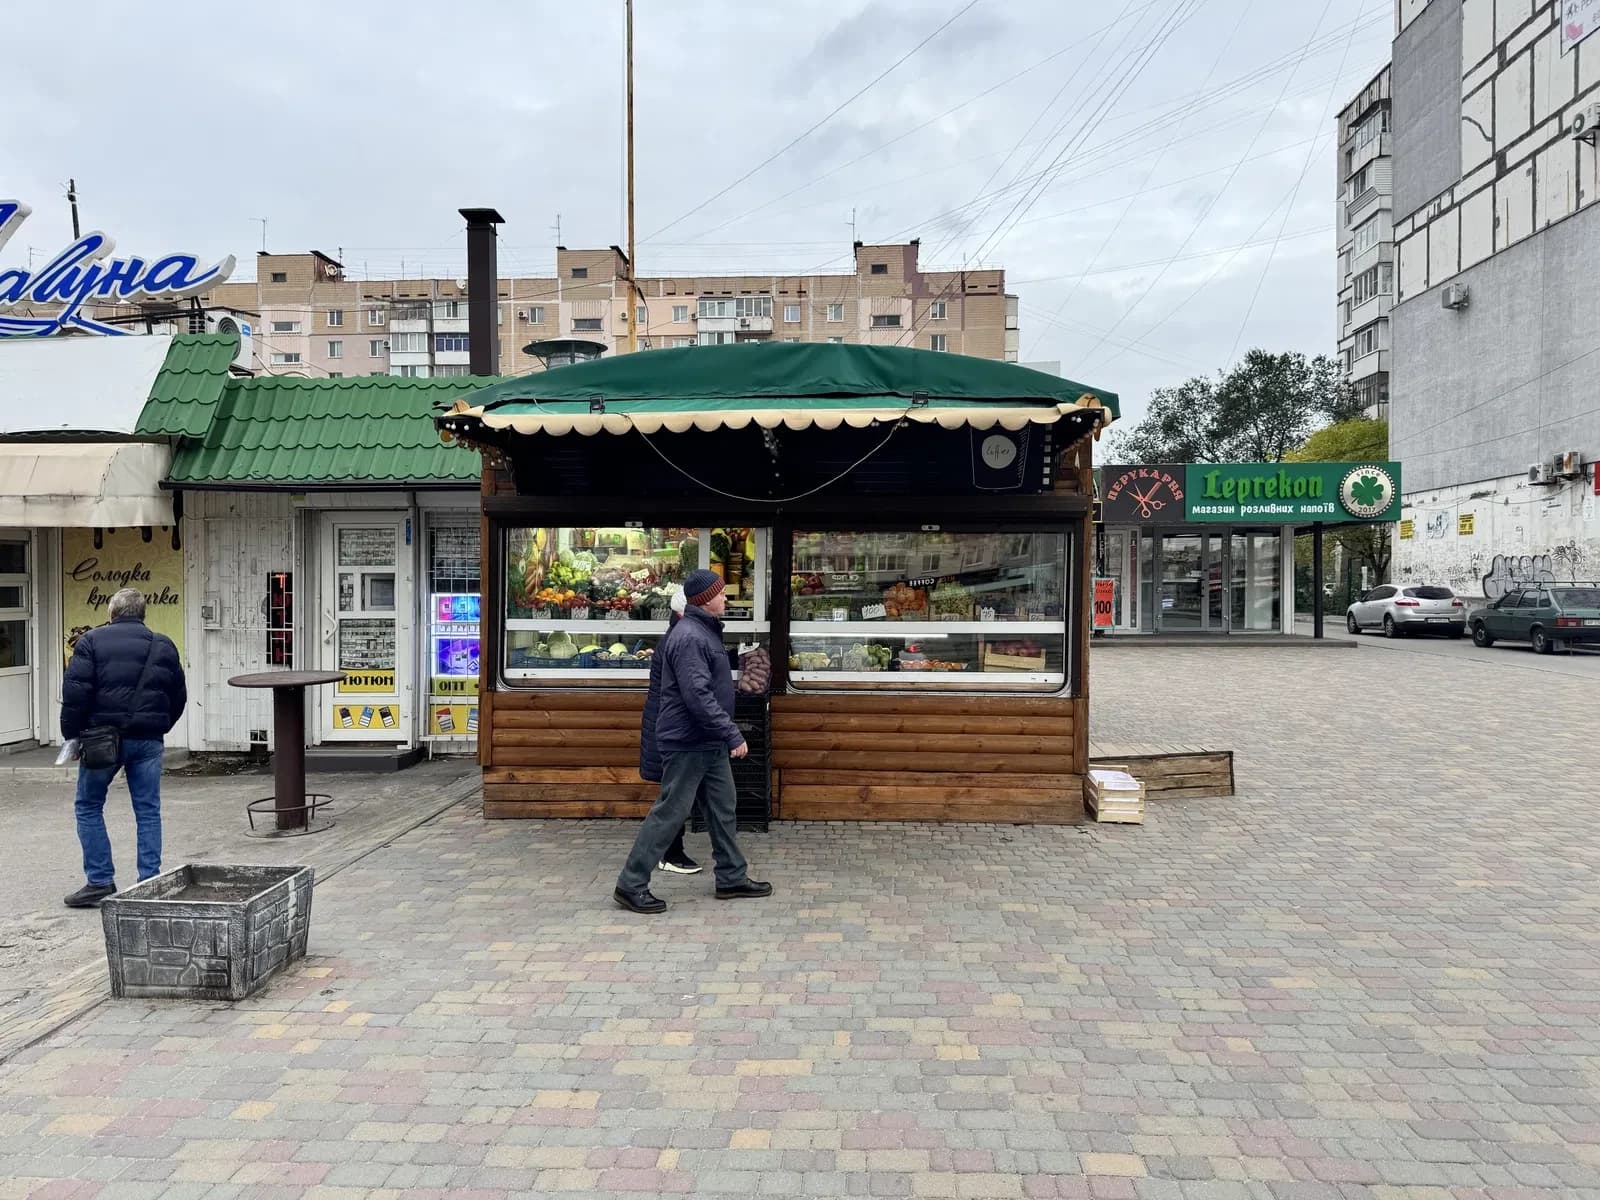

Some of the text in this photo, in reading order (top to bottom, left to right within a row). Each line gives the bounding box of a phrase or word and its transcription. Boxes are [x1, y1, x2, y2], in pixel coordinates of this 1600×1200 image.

[1106, 468, 1184, 501] ПЕРУКАРНЯ
[1203, 469, 1323, 504] Leprekon
[1192, 502, 1335, 517] магазин розливних напоїв
[65, 558, 151, 587] Солодка
[87, 586, 180, 611] кричка
[1094, 600, 1112, 614] 100
